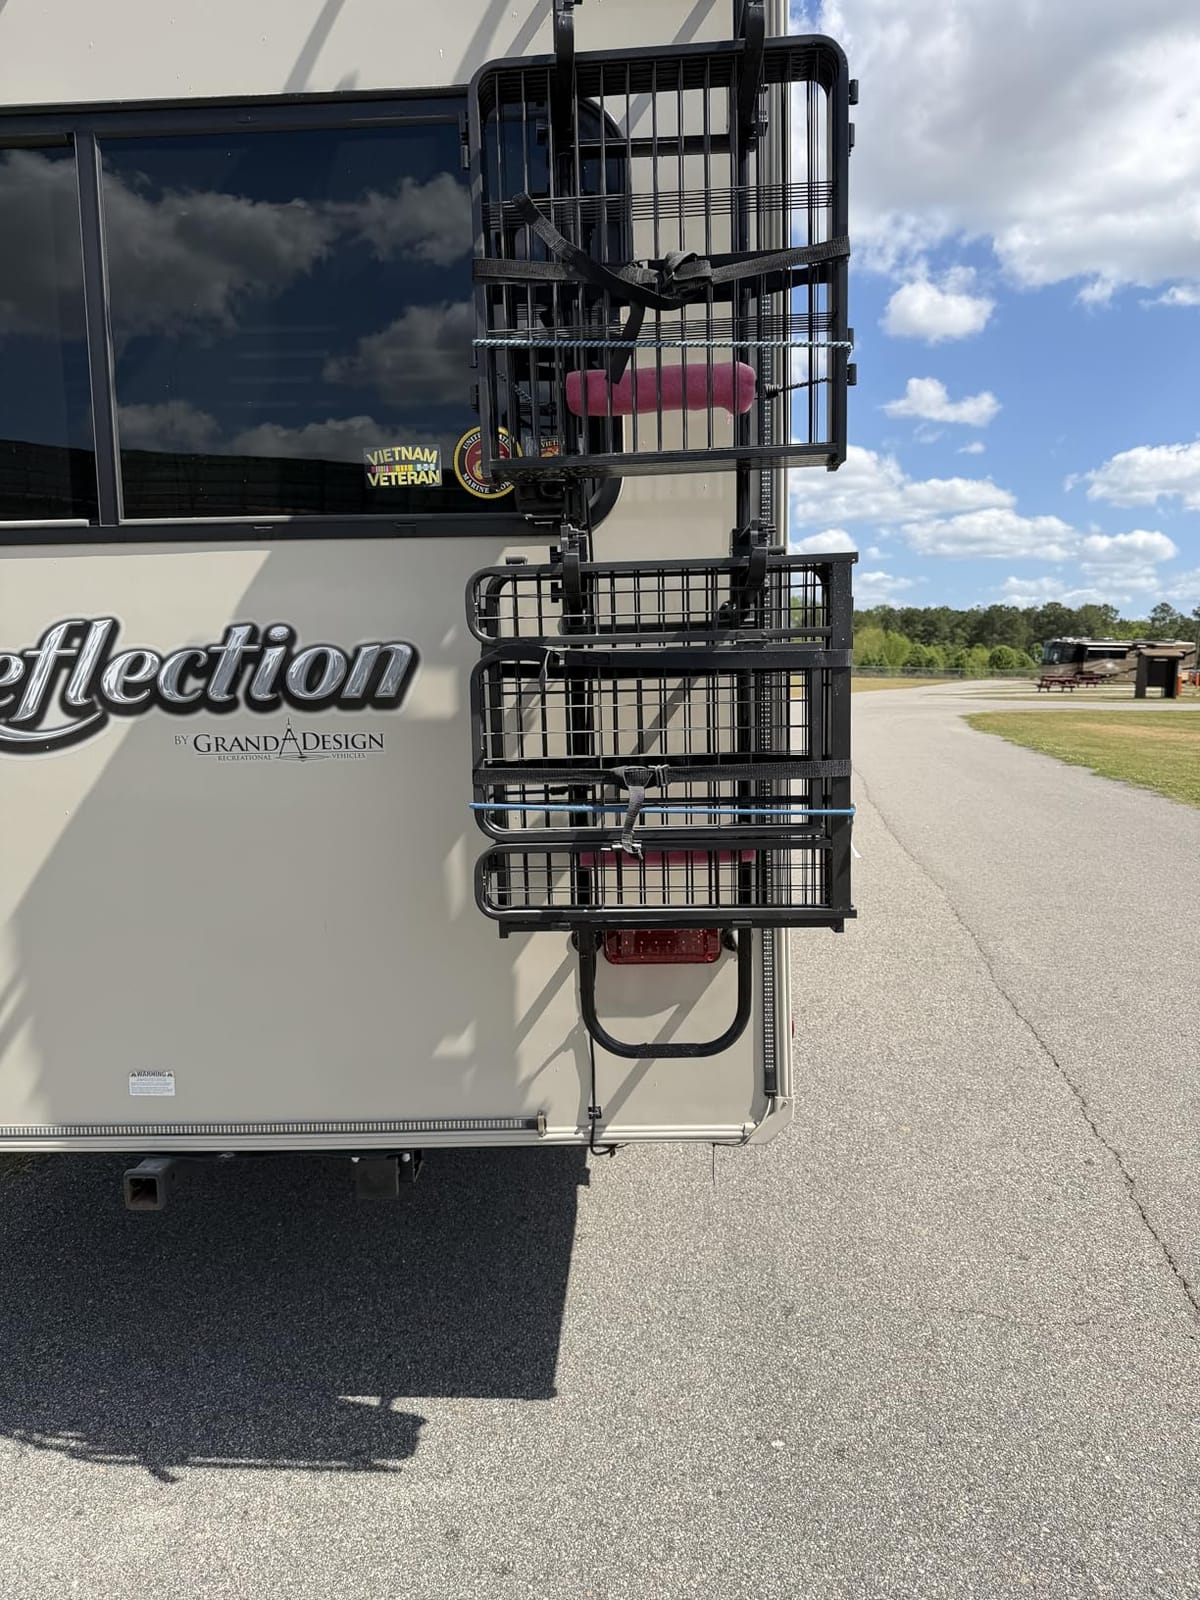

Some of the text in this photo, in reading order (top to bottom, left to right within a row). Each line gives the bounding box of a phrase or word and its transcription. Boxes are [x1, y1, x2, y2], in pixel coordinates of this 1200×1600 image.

[366, 446, 438, 466] VIETNAM
[367, 470, 440, 487] VETERAN
[462, 473, 490, 494] MARINE
[0, 616, 418, 741] eflection
[174, 732, 385, 753] BY GRAND DESIGN
